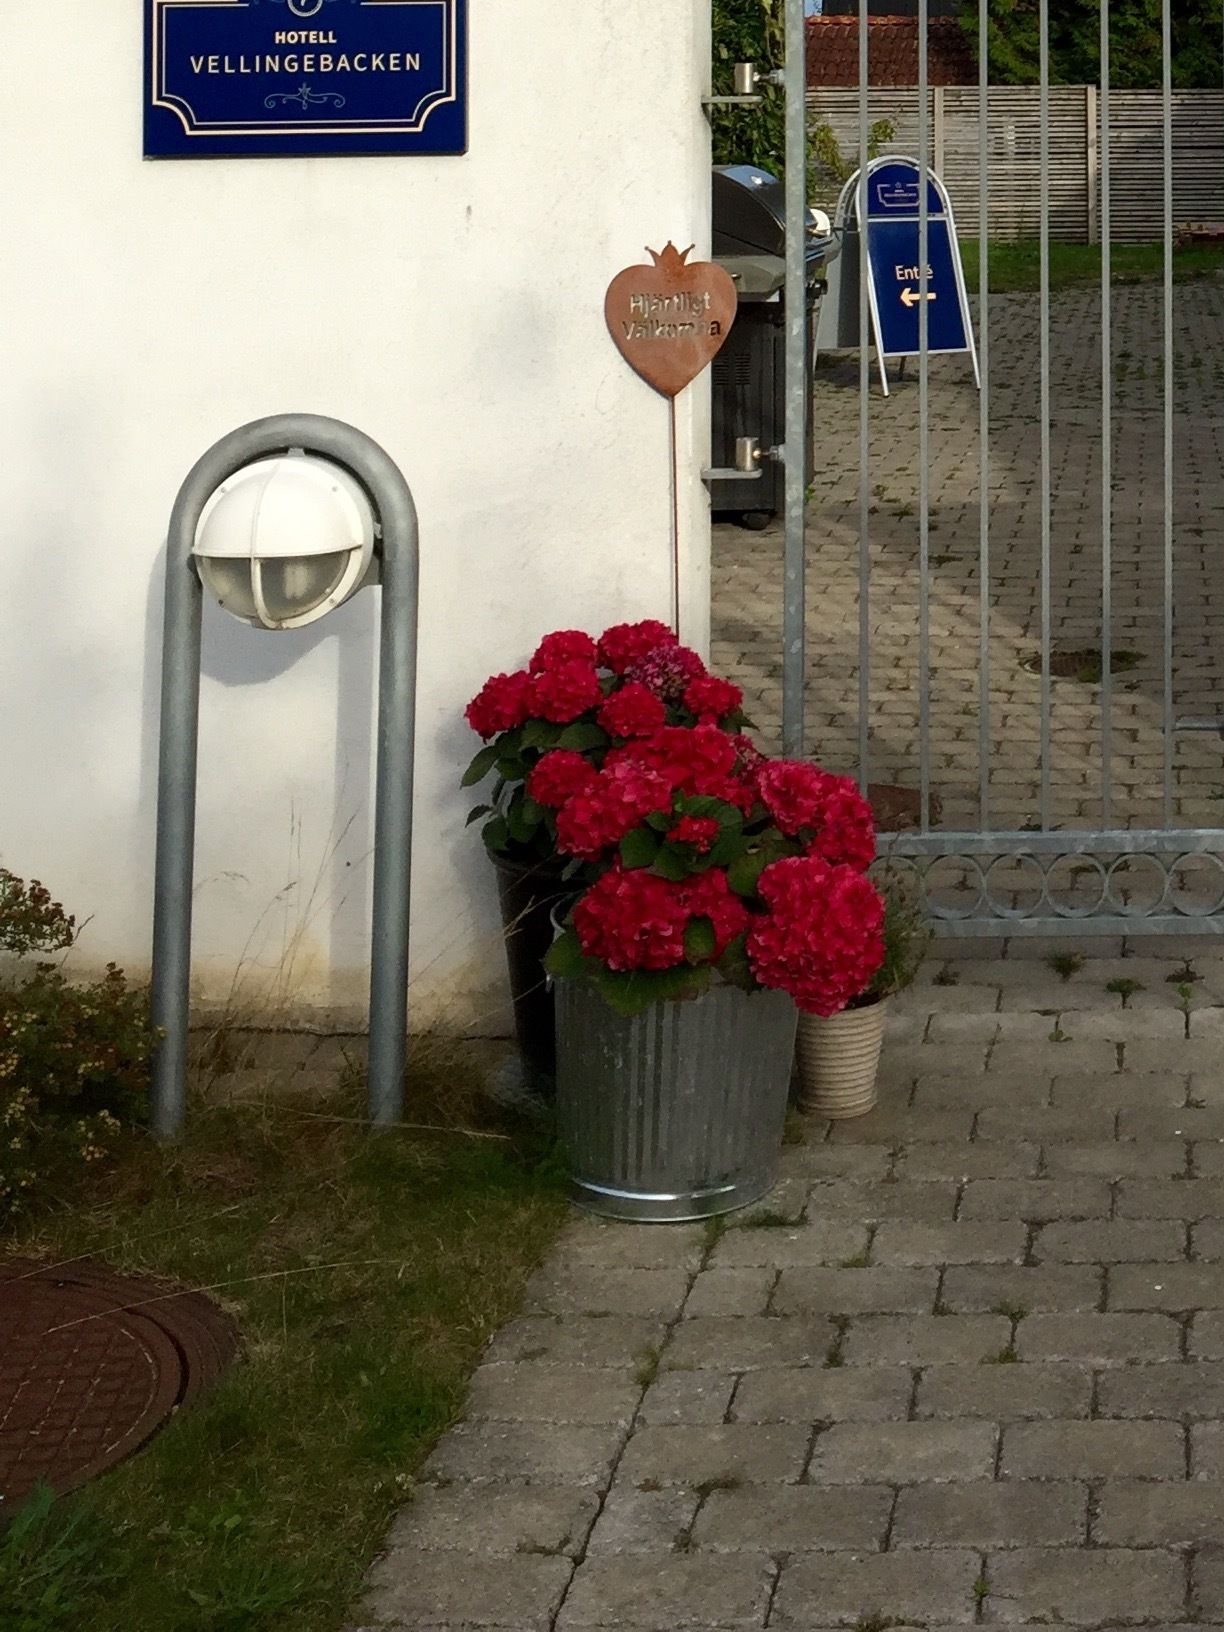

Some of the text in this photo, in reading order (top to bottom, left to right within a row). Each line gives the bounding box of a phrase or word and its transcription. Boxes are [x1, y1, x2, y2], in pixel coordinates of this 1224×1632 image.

[274, 30, 337, 44] HOTELL
[190, 53, 420, 74] VELLINGEBACKEN
[895, 264, 934, 280] Enté
